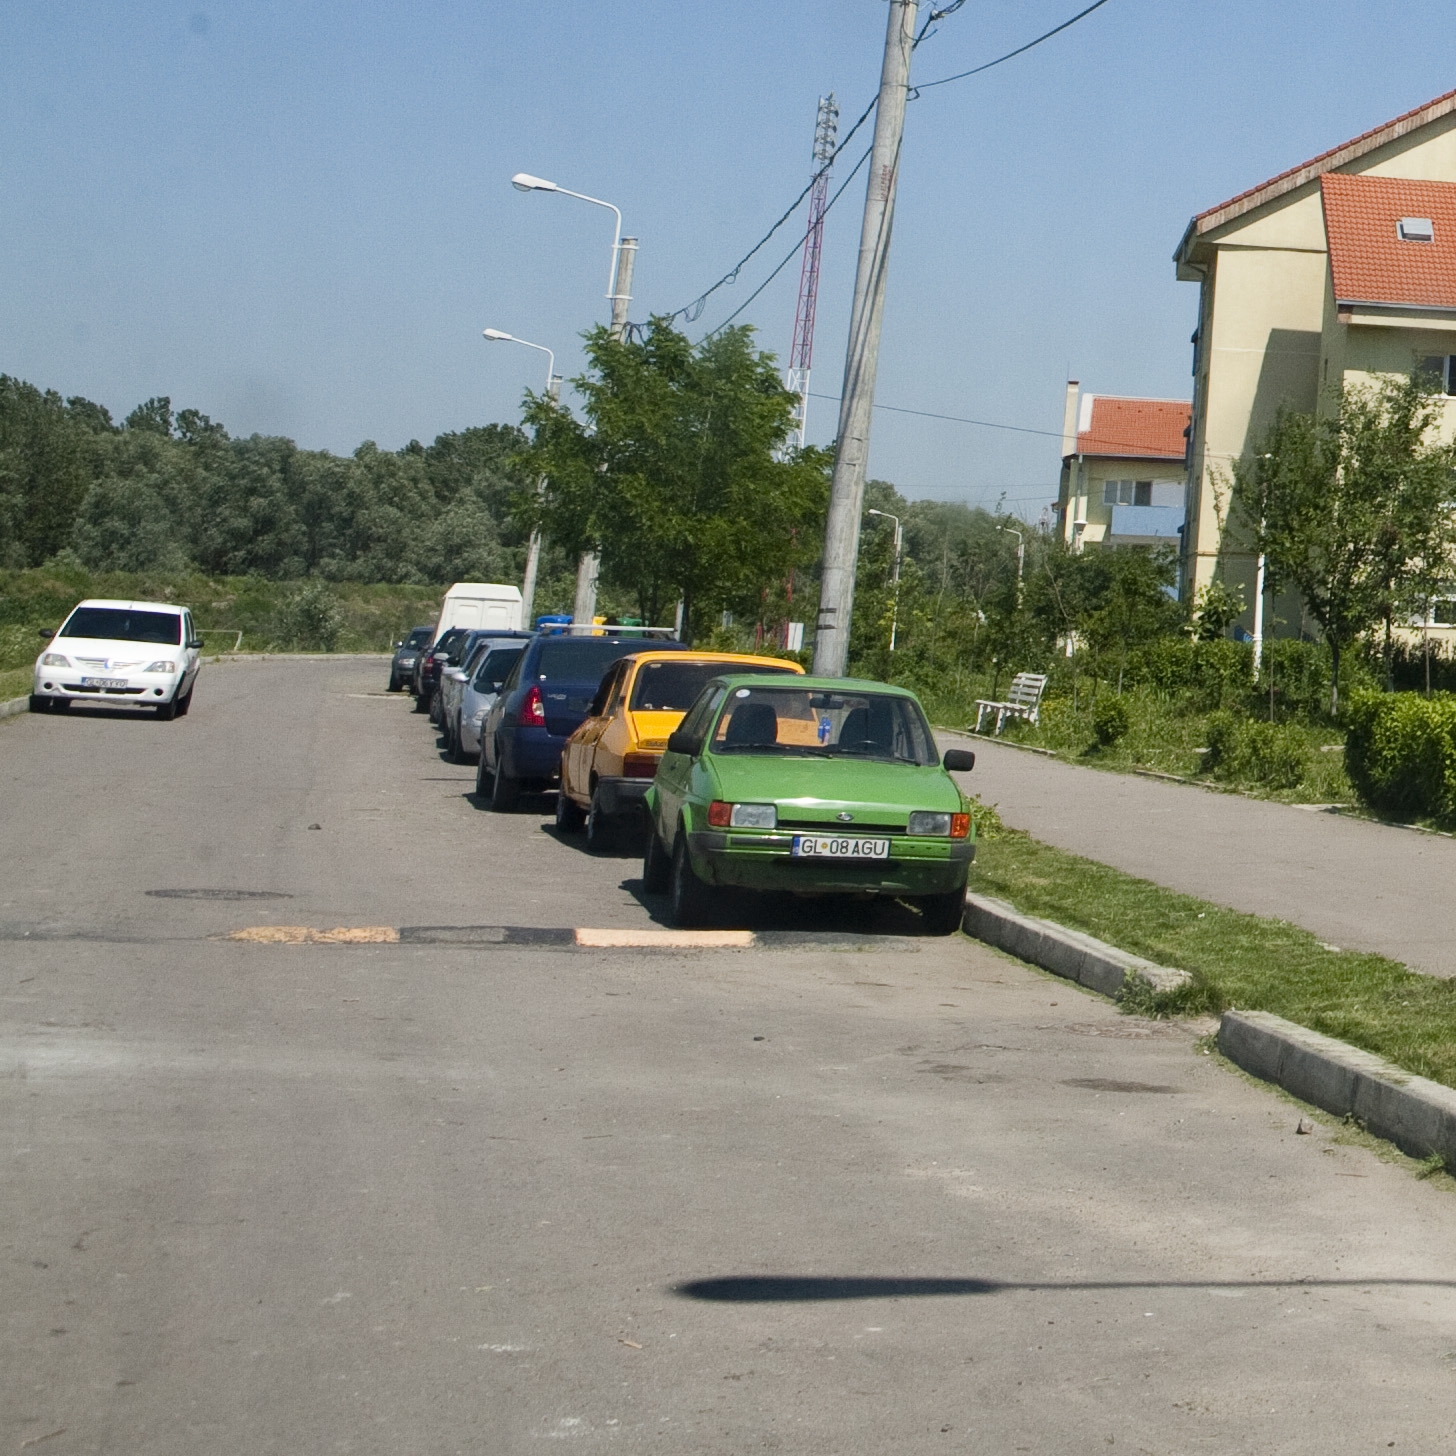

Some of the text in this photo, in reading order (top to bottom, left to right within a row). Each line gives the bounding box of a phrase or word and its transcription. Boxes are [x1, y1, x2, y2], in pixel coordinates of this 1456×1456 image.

[801, 838, 822, 855] GL
[829, 839, 849, 855] 08
[851, 840, 886, 856] AGU
